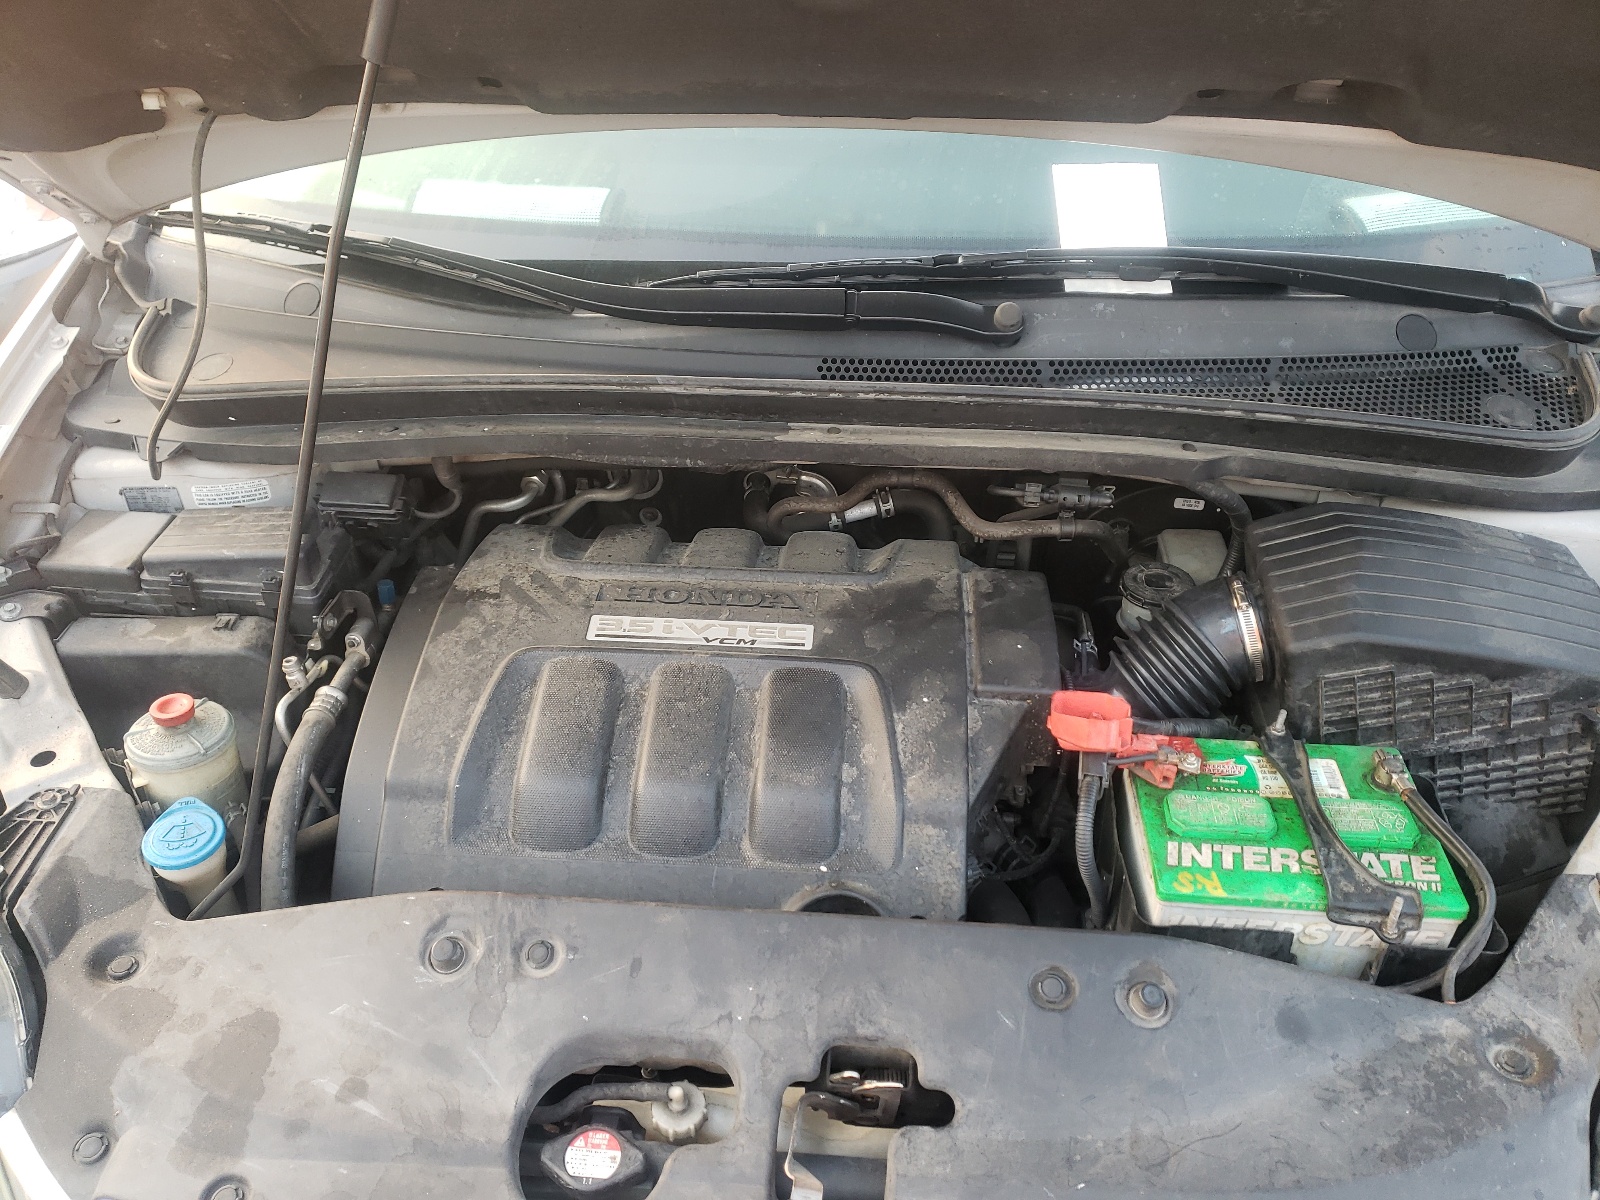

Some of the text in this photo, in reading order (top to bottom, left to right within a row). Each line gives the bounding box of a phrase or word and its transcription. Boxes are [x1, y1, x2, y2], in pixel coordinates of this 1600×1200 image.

[612, 584, 802, 610] HONDA
[702, 636, 758, 646] VCM
[1167, 841, 1441, 881] INTERSATE
